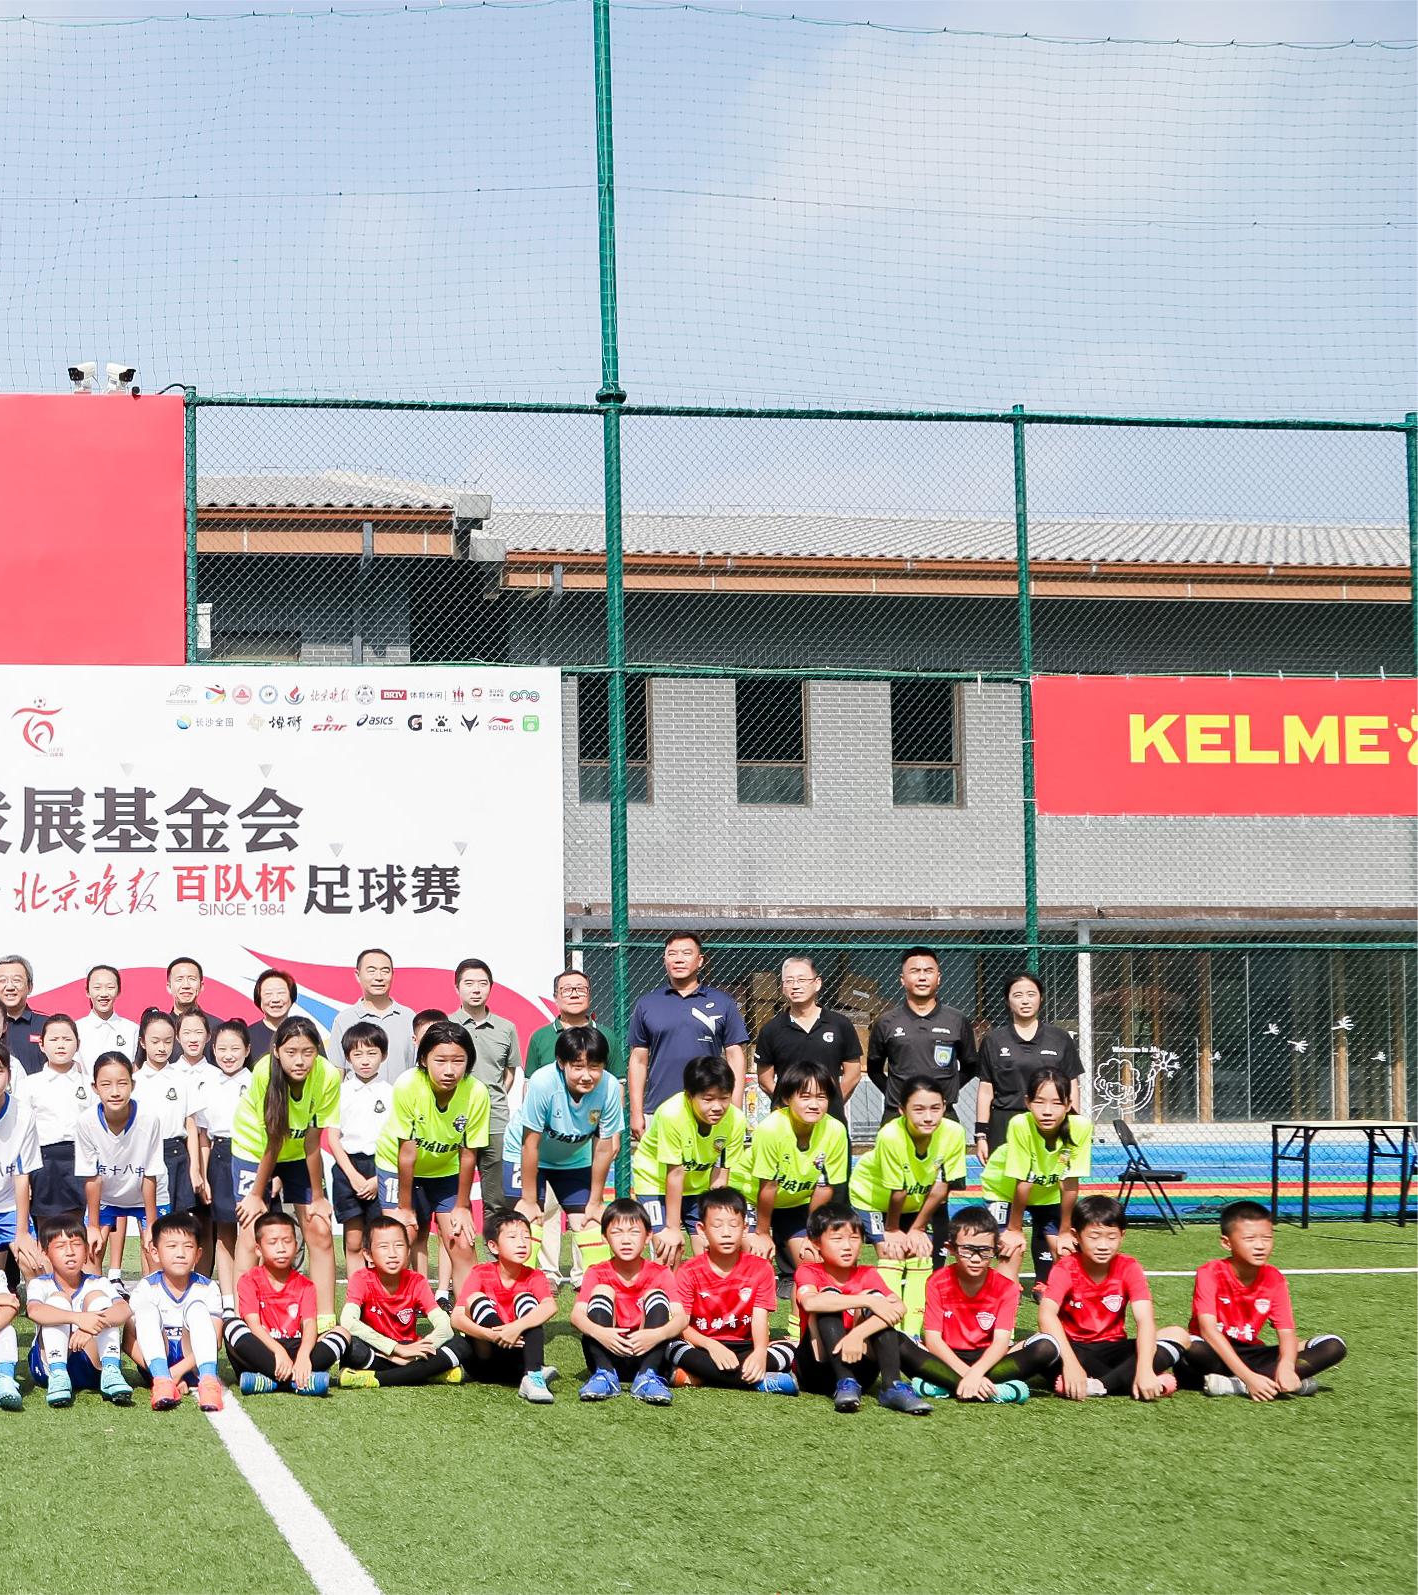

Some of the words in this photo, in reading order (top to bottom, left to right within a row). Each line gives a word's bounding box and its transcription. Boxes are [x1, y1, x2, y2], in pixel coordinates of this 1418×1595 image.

[1128, 714, 1390, 764] KELME
[198, 903, 246, 917] SINCE
[251, 903, 286, 917] 1984
